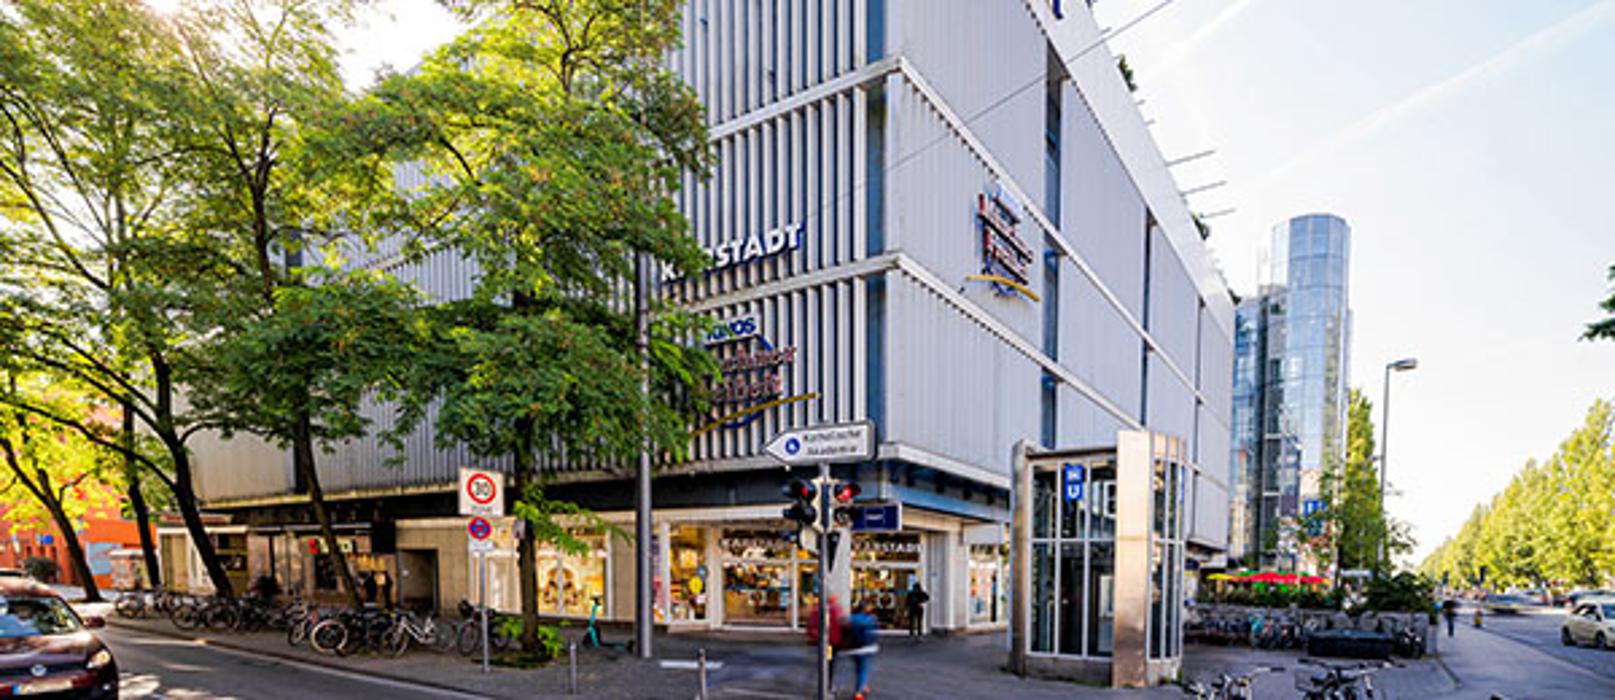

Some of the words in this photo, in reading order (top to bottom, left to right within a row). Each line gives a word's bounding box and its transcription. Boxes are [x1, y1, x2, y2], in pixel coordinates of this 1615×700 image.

[661, 223, 804, 281] KSTADT
[474, 481, 490, 496] 30
[1067, 484, 1080, 498] U
